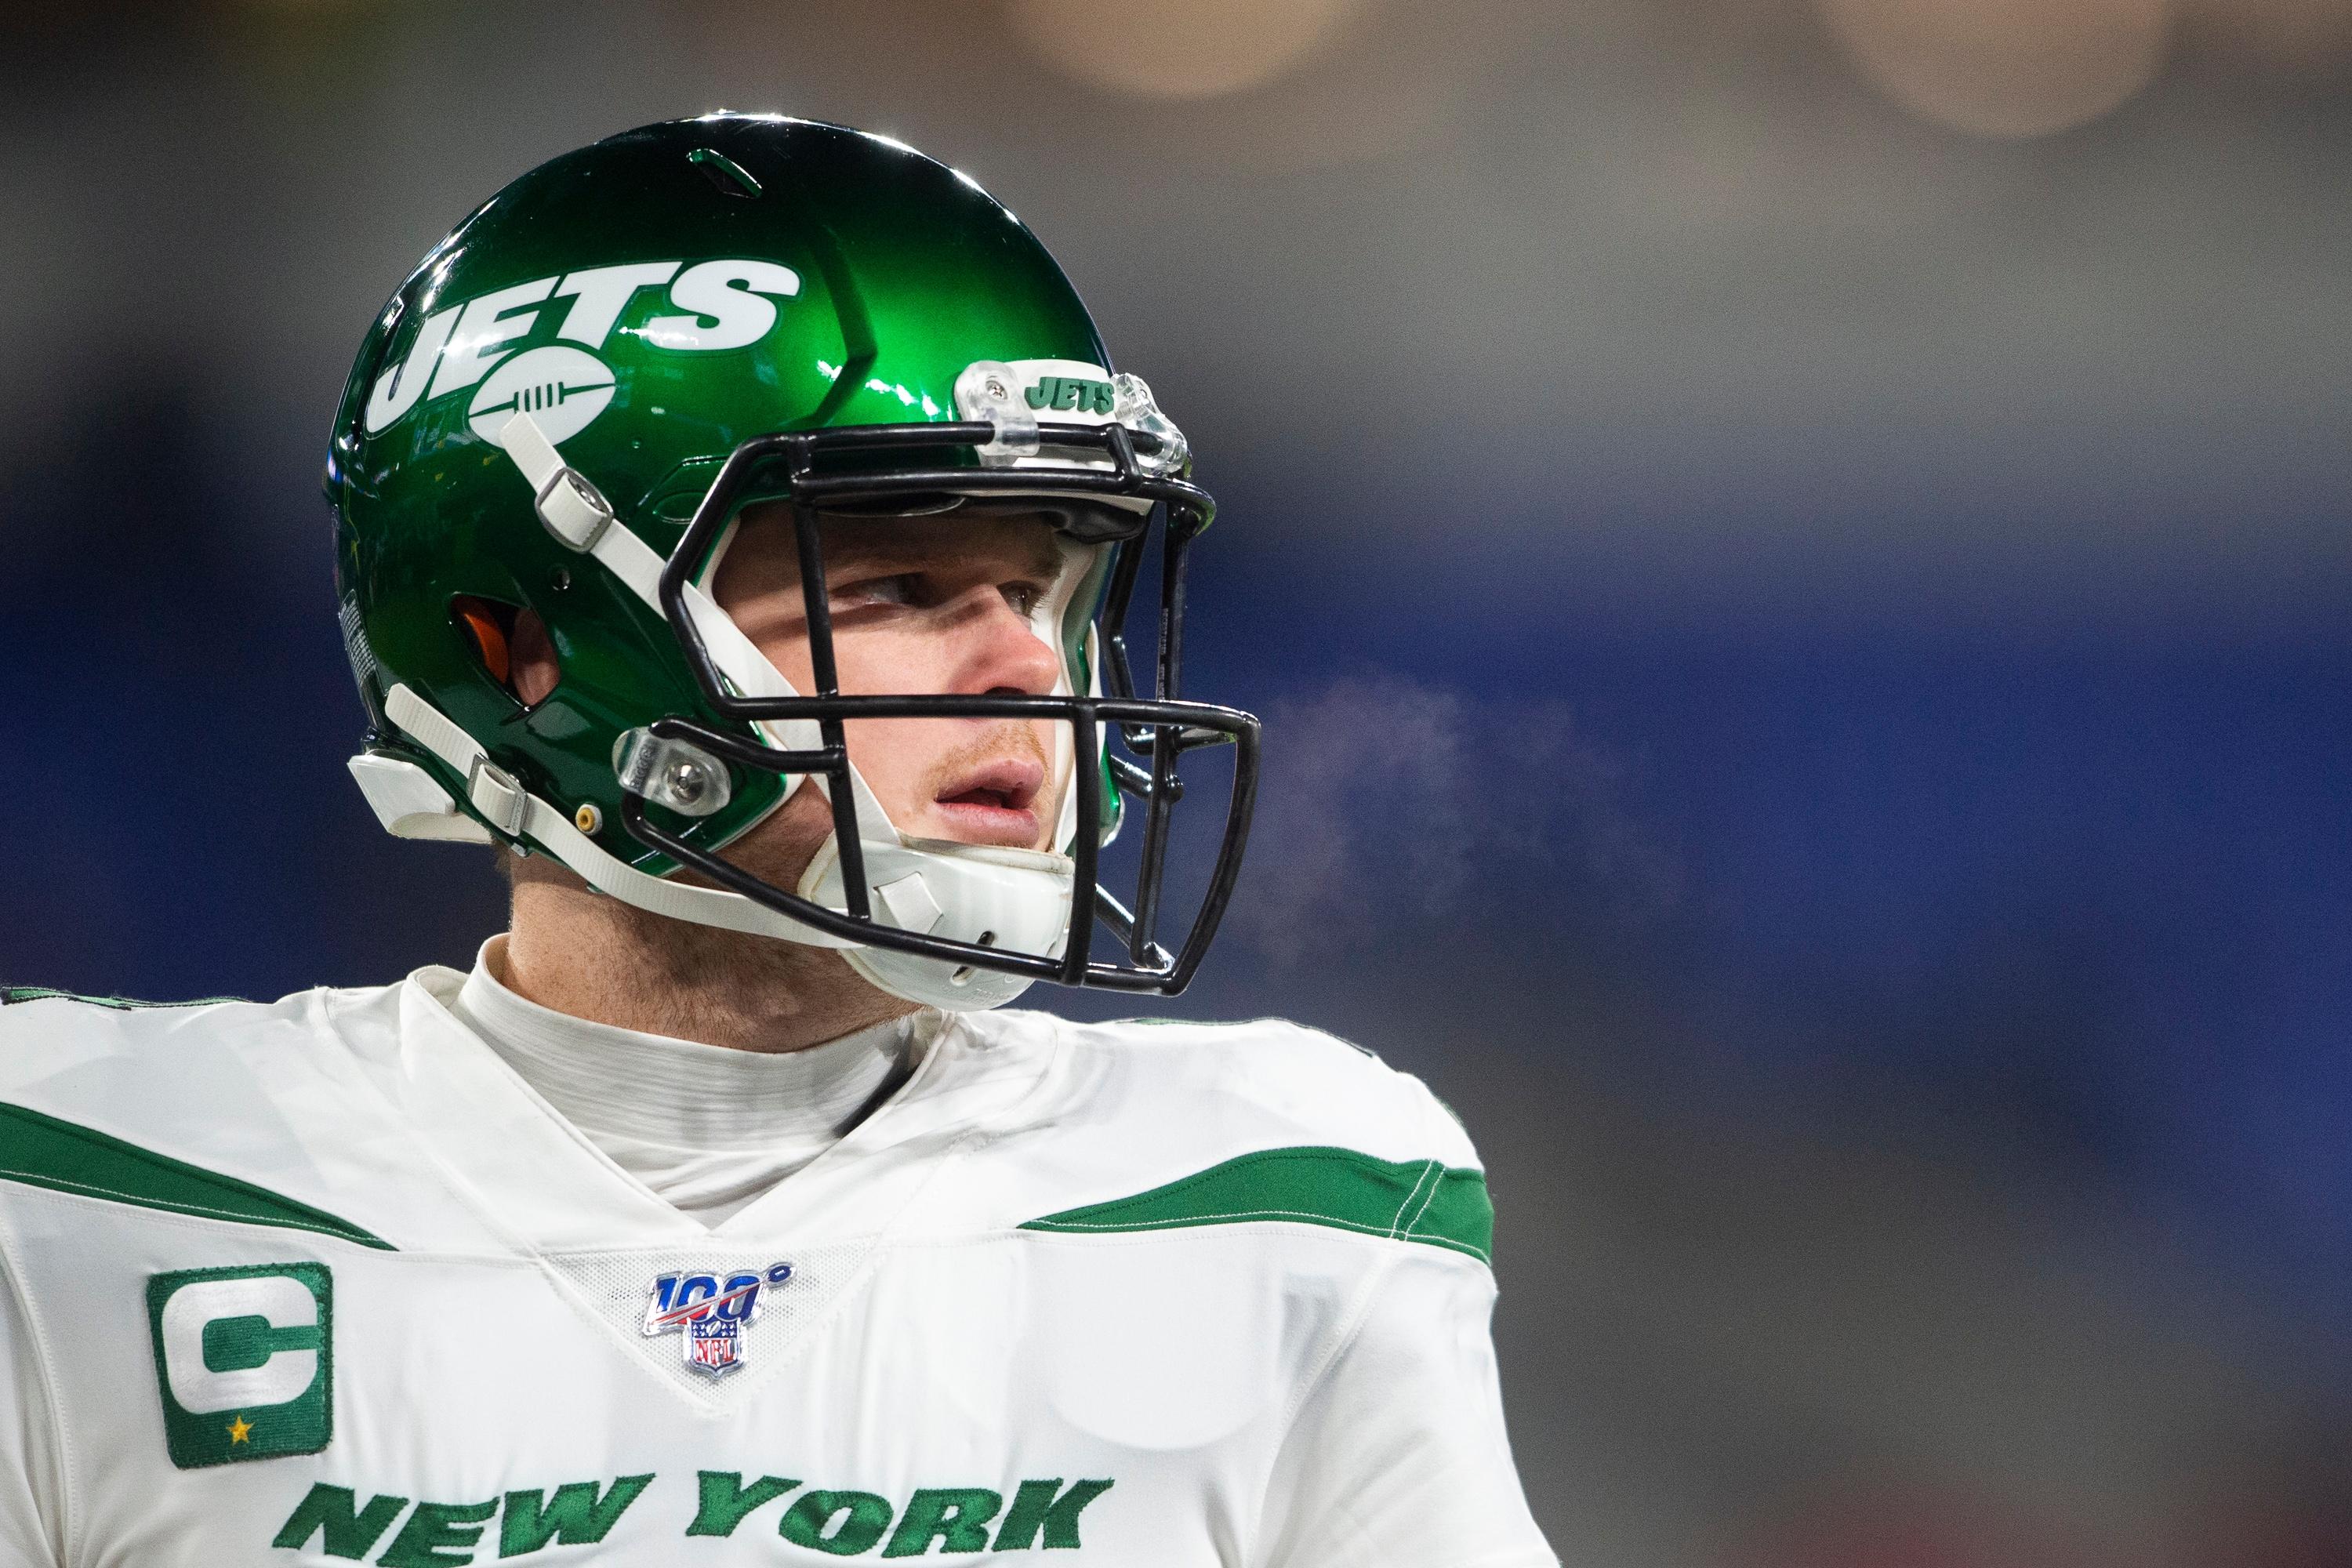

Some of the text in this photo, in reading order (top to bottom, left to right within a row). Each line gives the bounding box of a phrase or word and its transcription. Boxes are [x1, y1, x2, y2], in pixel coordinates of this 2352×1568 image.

[364, 260, 800, 433] JETS
[1025, 376, 1114, 416] JETS
[648, 1273, 761, 1324] 100
[162, 1276, 318, 1414] C
[695, 1338, 736, 1367] NFL
[272, 1470, 1115, 1568] NEW YORK
